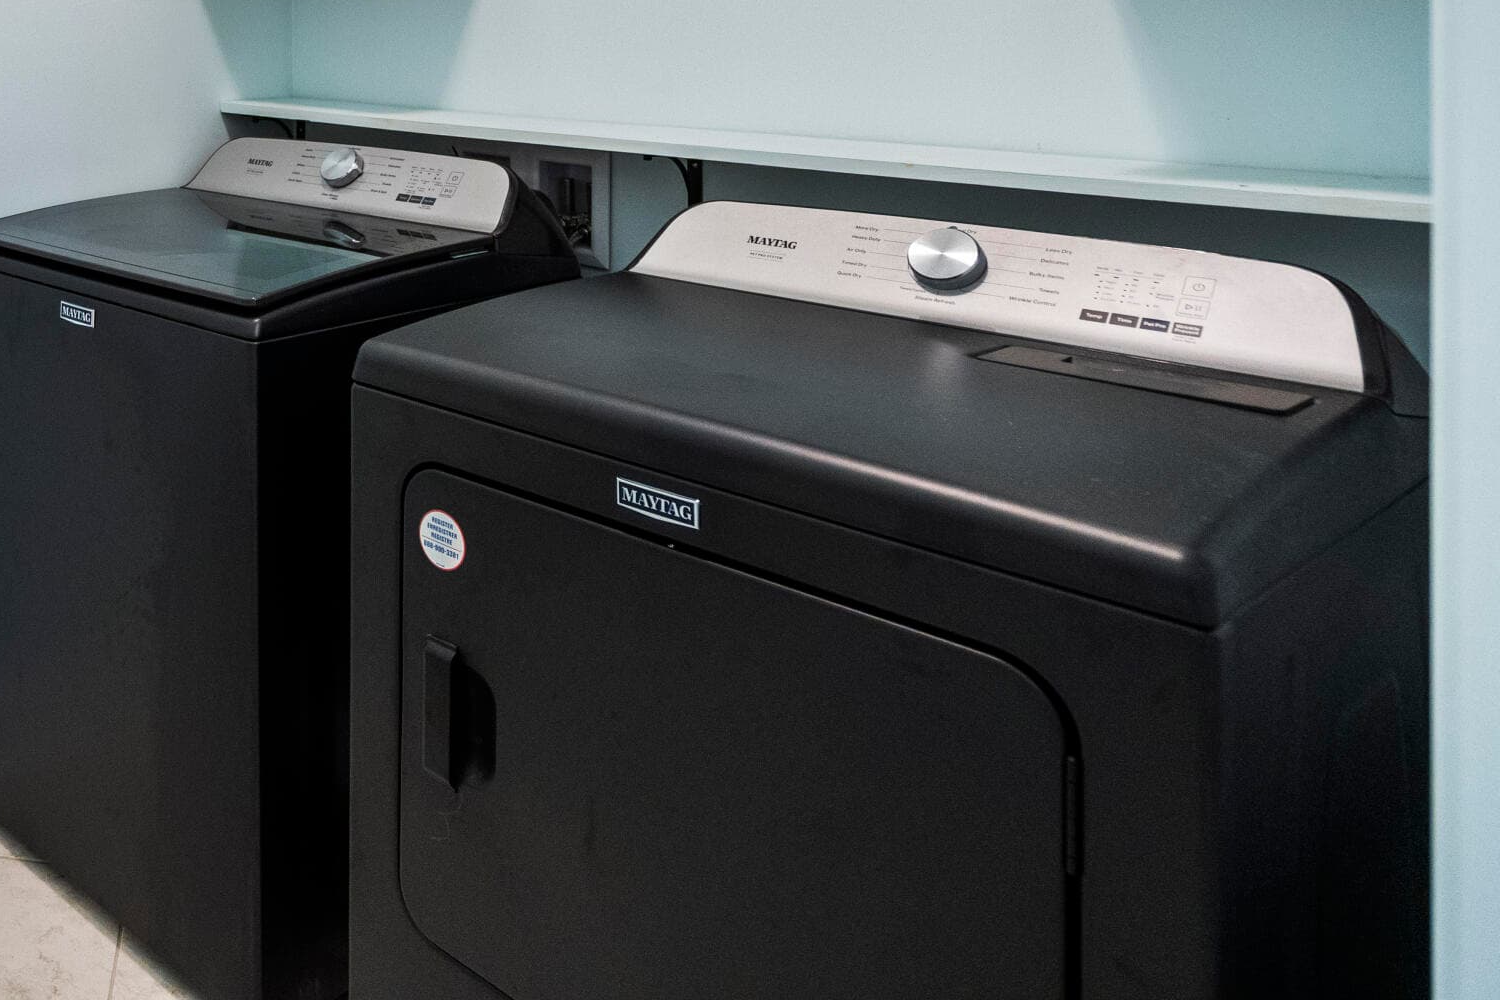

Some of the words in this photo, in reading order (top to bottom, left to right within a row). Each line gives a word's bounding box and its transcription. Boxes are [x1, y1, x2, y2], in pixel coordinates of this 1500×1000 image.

[247, 158, 274, 168] MAYTAG
[746, 235, 798, 250] MAYTAG
[61, 306, 92, 324] MAYTAG
[621, 486, 693, 521] MAYTAG
